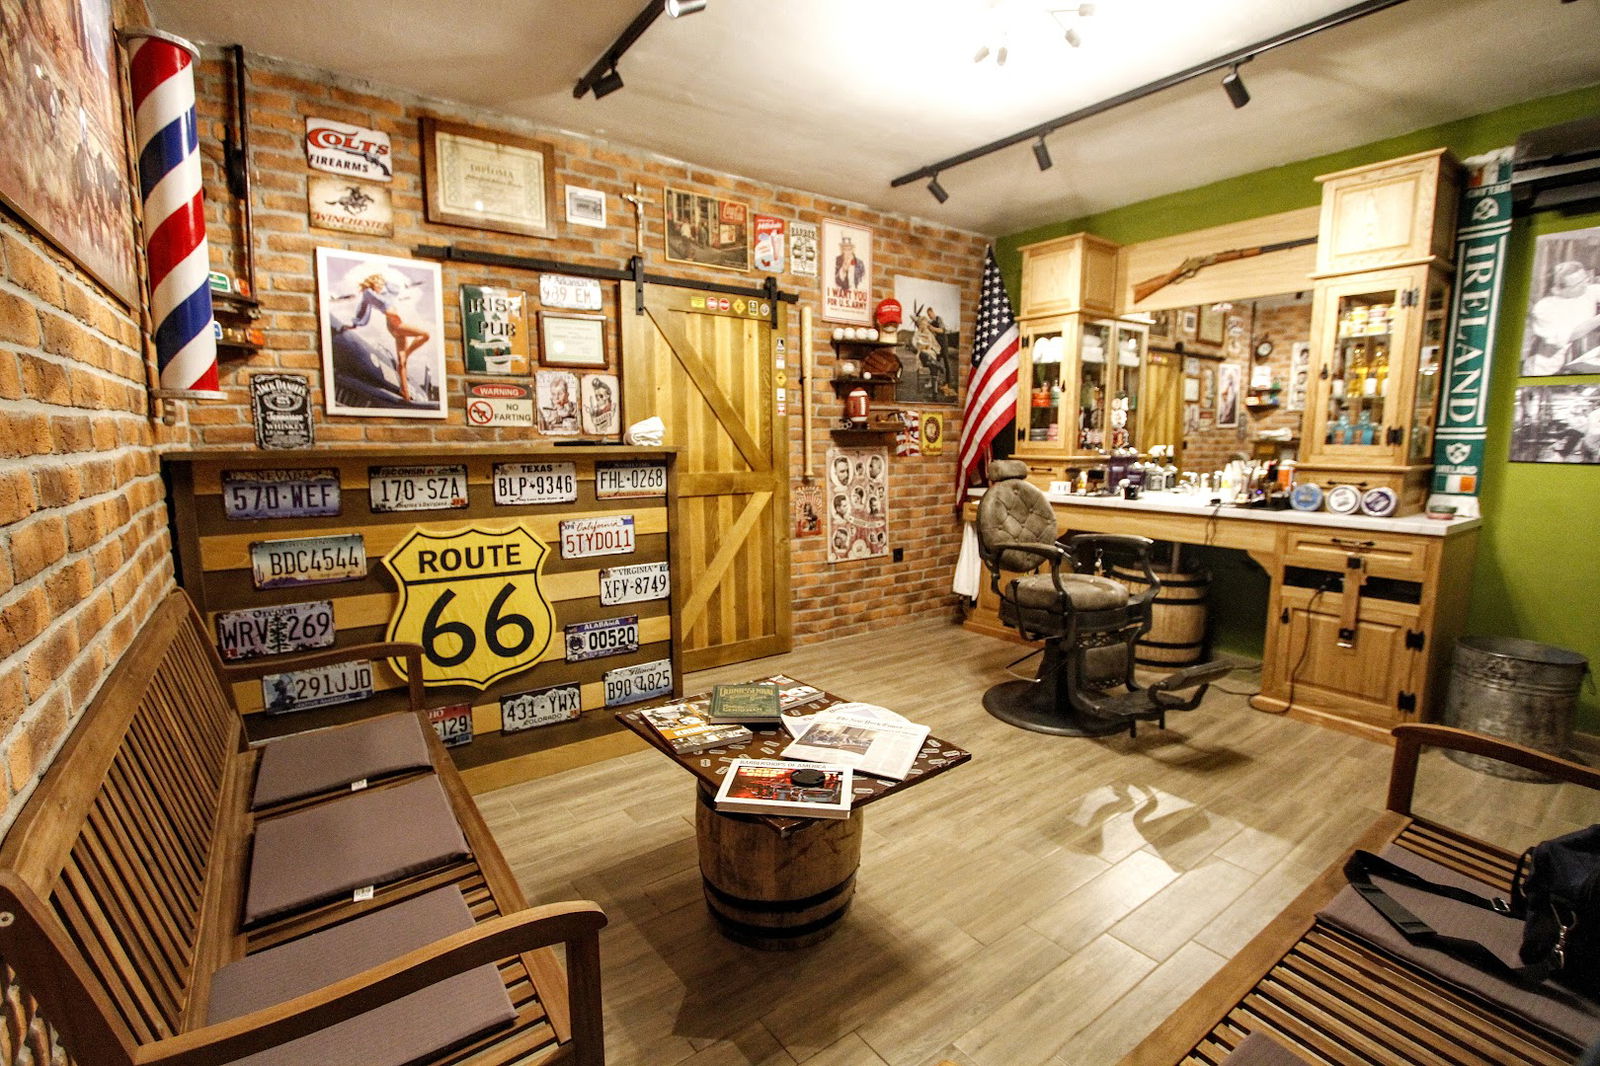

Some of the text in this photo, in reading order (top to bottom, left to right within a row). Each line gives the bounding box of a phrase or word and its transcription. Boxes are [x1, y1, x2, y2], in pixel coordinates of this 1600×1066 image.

[307, 128, 390, 155] COLTS
[309, 154, 369, 173] FIREARMS
[828, 298, 837, 306] FOR
[833, 289, 852, 299] WANT
[855, 291, 868, 301] YOU
[478, 321, 516, 337] PUB
[1447, 242, 1498, 424] IRELAND
[479, 387, 520, 397] WARNING
[506, 403, 519, 411] NO
[520, 464, 553, 473] TEXAS
[381, 477, 460, 502] 170-SZA
[498, 475, 573, 497] BLP 9346
[577, 520, 623, 532] California
[269, 546, 359, 576] BDC4544
[418, 543, 522, 574] ROUTE
[618, 565, 653, 576] VIRGINIA
[252, 607, 298, 618] Oregon
[221, 612, 330, 649] WRV 269
[422, 582, 535, 668] 66
[584, 619, 621, 630] ALABAMA
[589, 626, 635, 650] 00520
[295, 668, 371, 700] 291JJD
[607, 669, 670, 701] B90 4825
[524, 713, 563, 726] COLORADO
